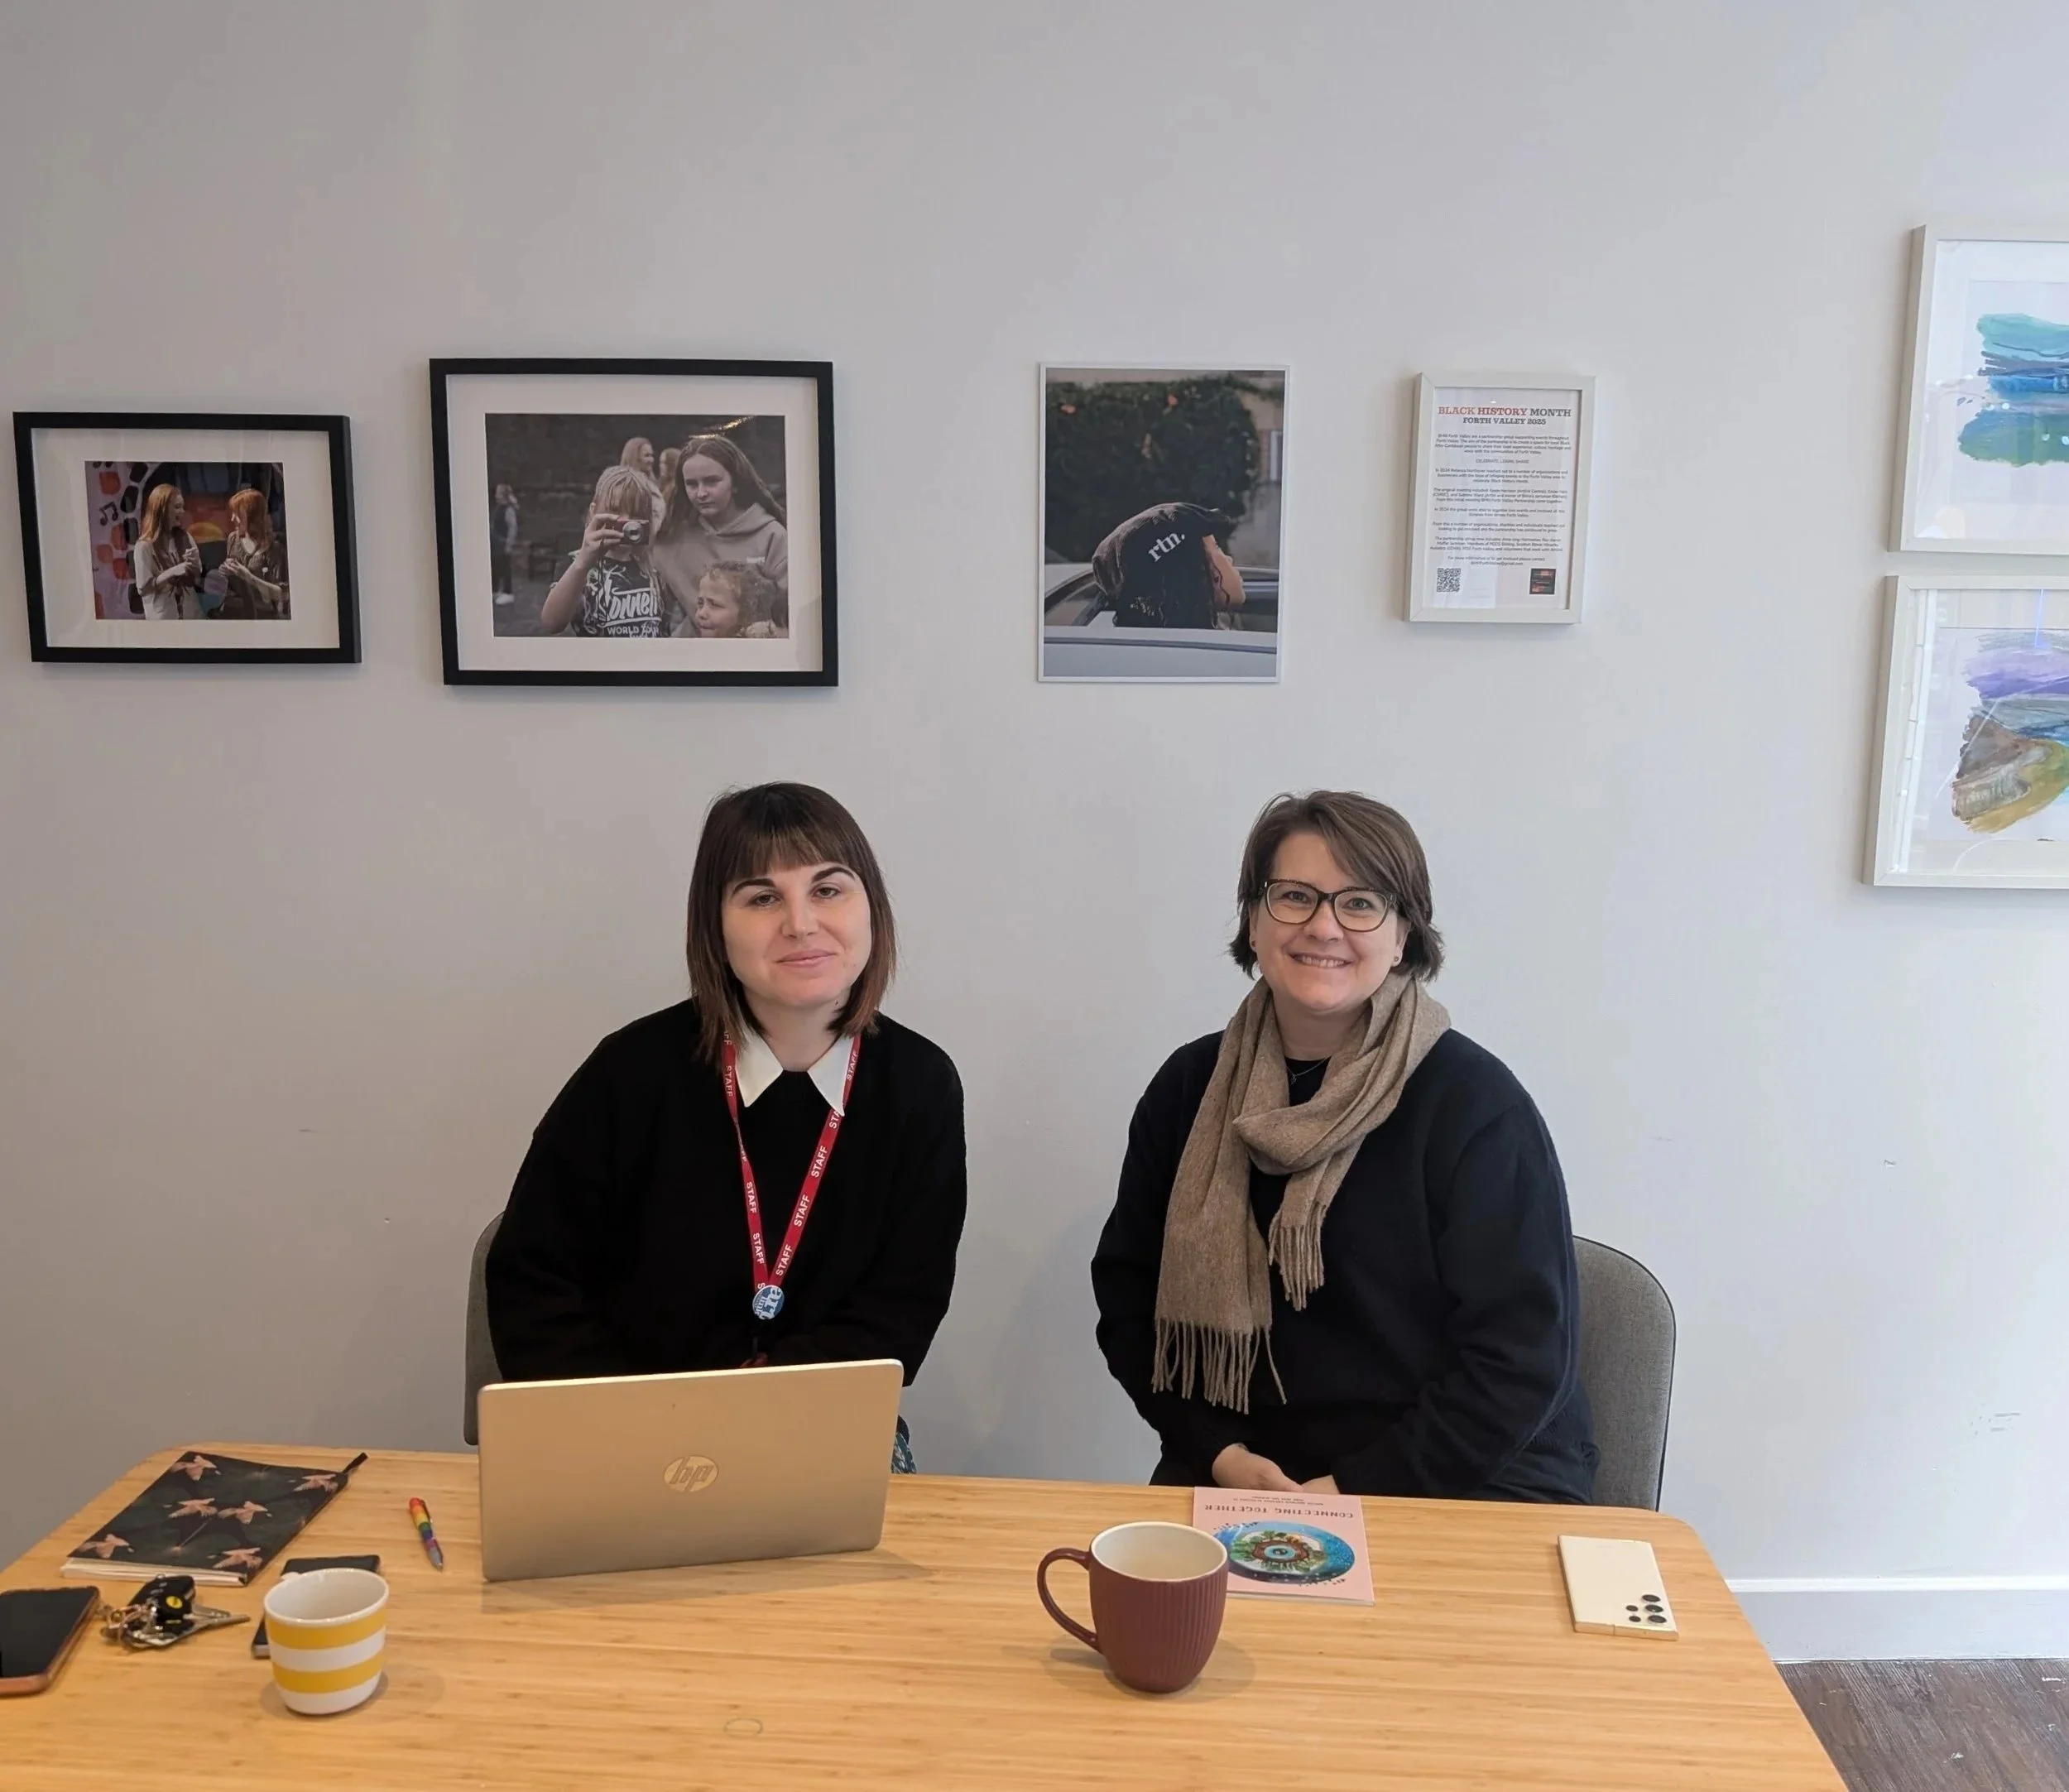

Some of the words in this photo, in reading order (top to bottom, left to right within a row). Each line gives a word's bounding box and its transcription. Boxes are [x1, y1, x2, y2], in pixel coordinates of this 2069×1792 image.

[1438, 406, 1475, 415] BLACK
[1477, 407, 1527, 416] HISTORY
[1529, 408, 1572, 416] MONTH
[1149, 533, 1185, 562] rtn.
[607, 626, 640, 637] WORLD
[846, 1050, 858, 1081] STAFF
[724, 1065, 734, 1097] STAFF
[746, 1181, 758, 1213] STAFF
[752, 1232, 766, 1265] STAFF
[775, 1244, 793, 1276] STAFF
[794, 1194, 810, 1227] STAFF
[811, 1145, 828, 1178] STAFF
[1205, 1505, 1267, 1514] TOGETHER
[1275, 1508, 1354, 1518] CONNECTING
